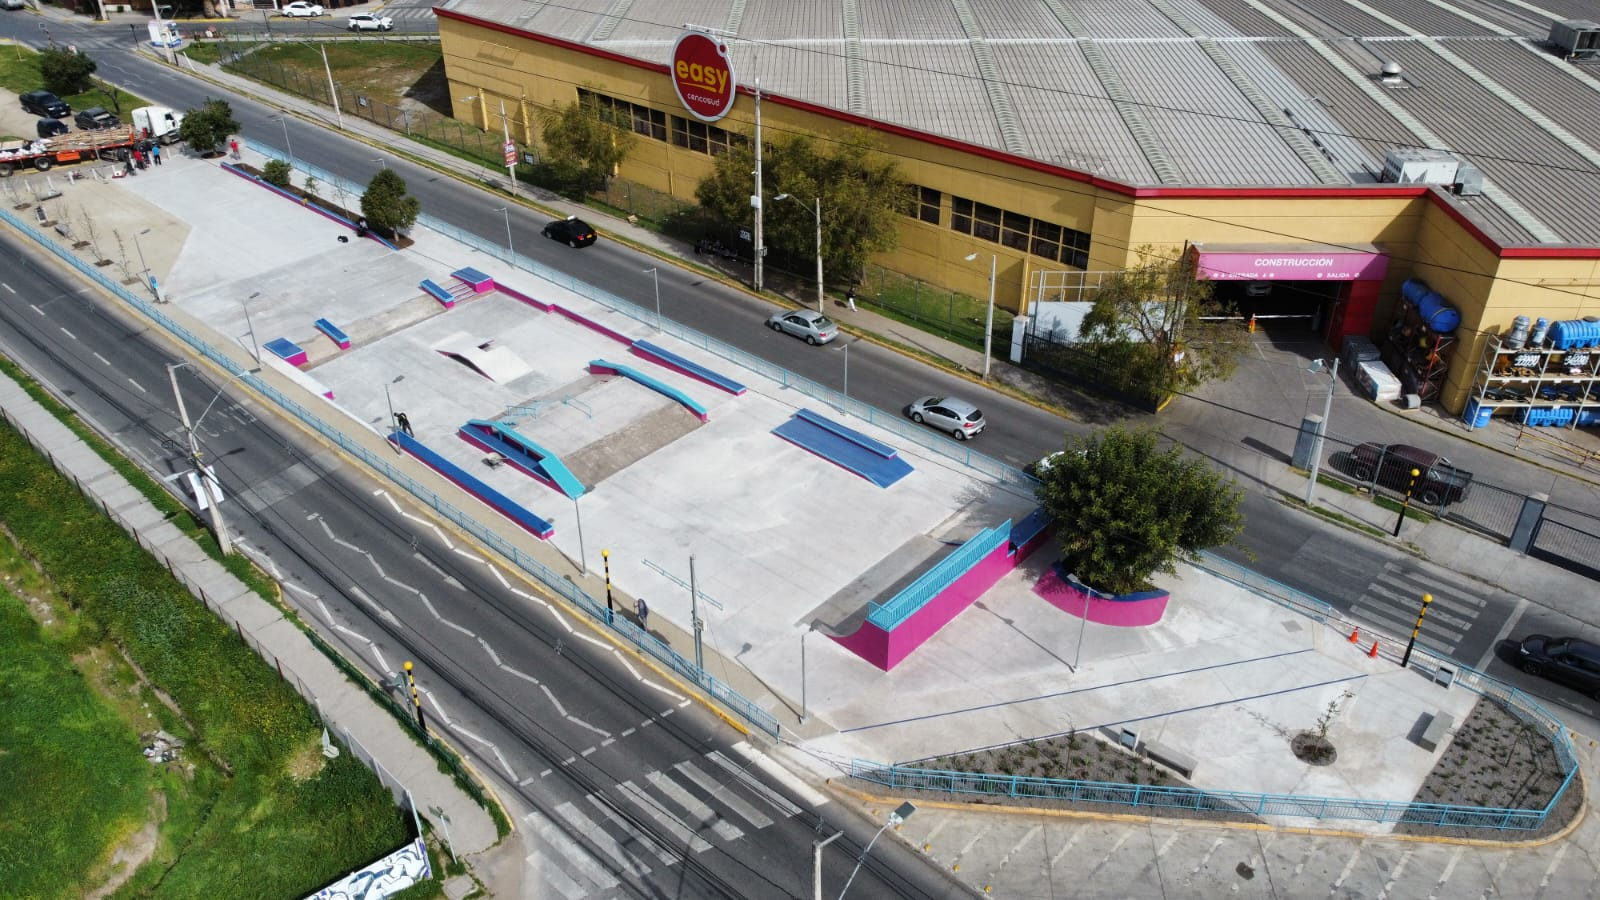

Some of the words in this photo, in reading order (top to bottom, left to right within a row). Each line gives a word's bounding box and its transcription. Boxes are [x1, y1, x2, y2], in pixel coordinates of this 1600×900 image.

[676, 60, 728, 94] easy
[687, 93, 720, 106] cencosud
[1254, 257, 1334, 267] CONSTRUCCIÓN
